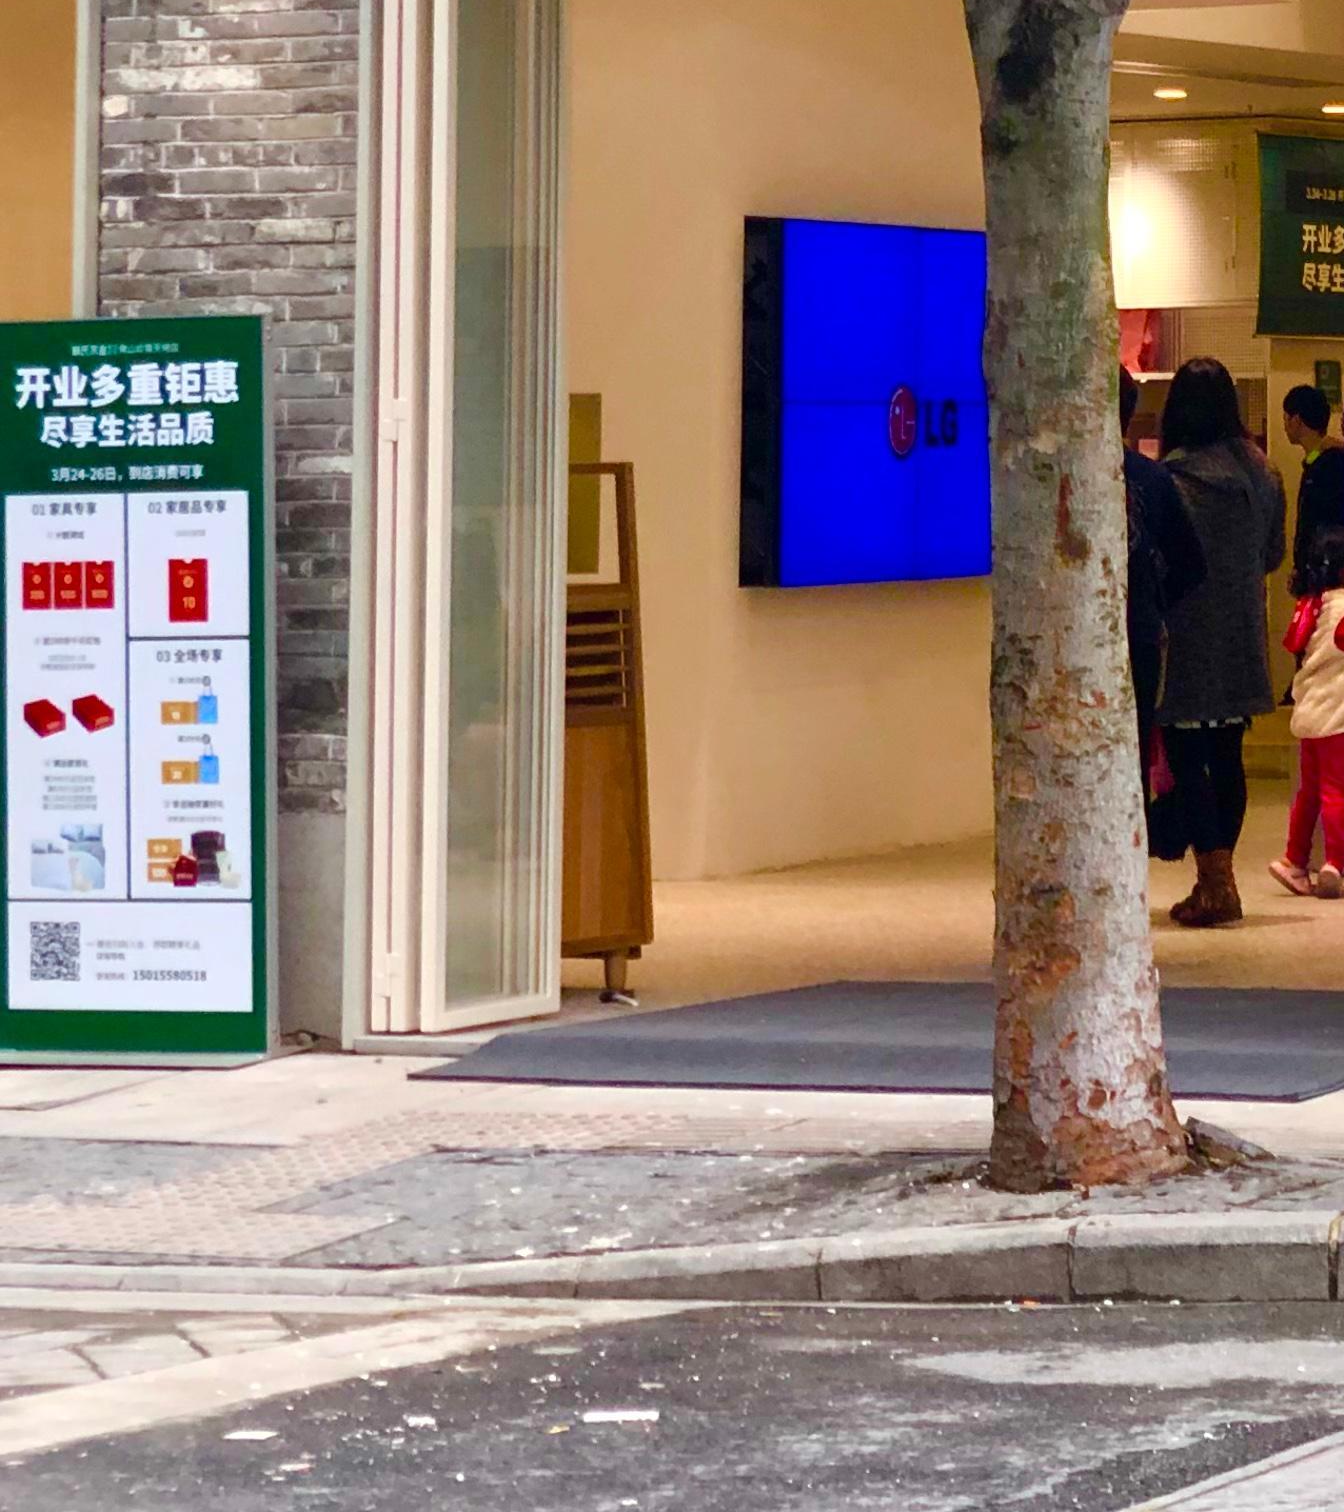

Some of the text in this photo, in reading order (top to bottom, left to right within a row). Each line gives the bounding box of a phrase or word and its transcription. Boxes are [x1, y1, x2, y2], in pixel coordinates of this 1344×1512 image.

[15, 360, 239, 409] 开业多重钜惠
[40, 410, 214, 448] 尽享生活品质
[924, 400, 958, 446] LG
